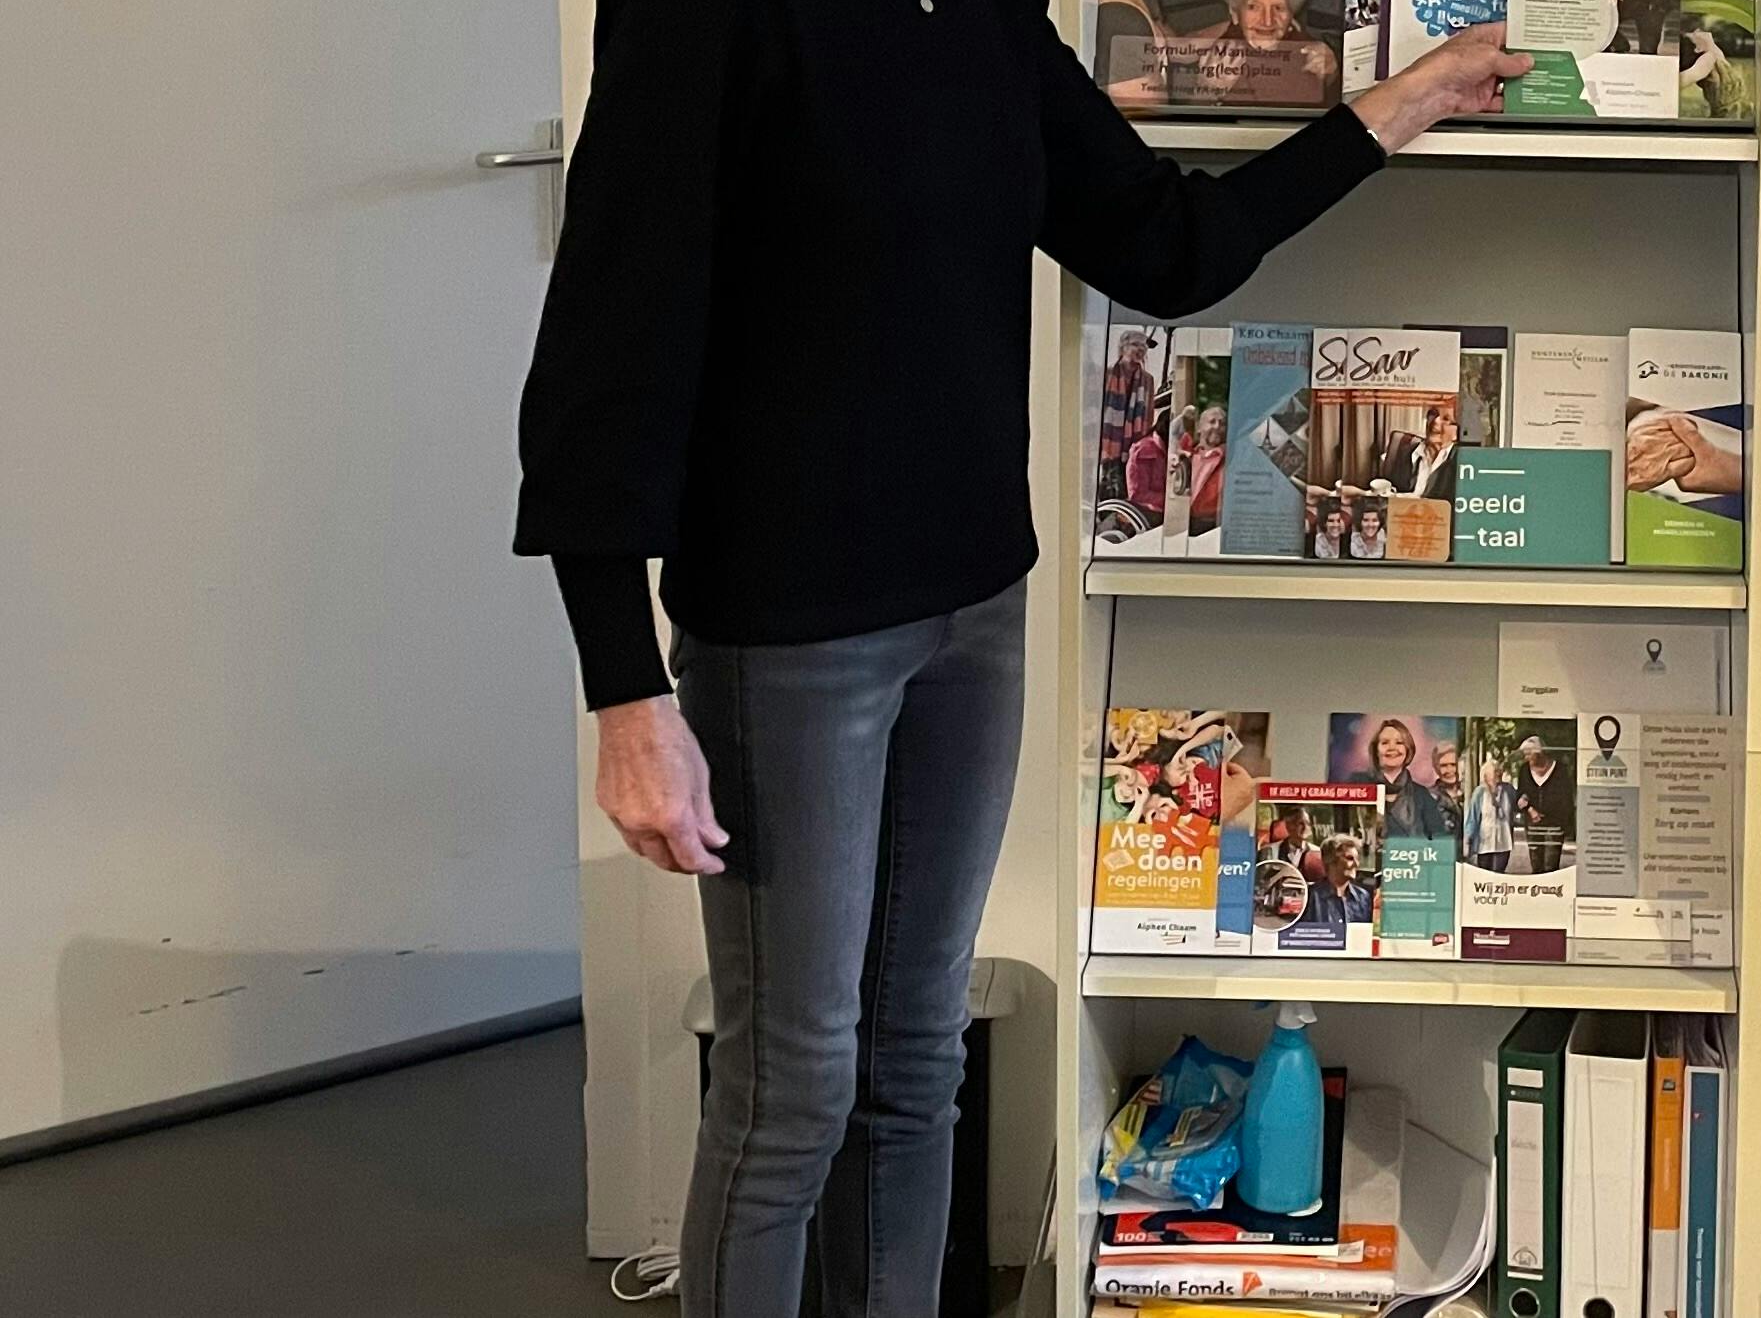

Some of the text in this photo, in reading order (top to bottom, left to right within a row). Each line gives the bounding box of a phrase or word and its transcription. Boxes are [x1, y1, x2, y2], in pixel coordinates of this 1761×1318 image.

[1142, 42, 1208, 57] Formulier
[1680, 369, 1730, 381] BARONIE
[1476, 527, 1526, 548] taal
[1520, 685, 1559, 696] Zorgplan
[1110, 825, 1168, 851] Mee
[1137, 849, 1204, 872] doen
[1390, 848, 1438, 864] zeg ik
[1106, 871, 1202, 893] regelingen
[1473, 882, 1494, 894] Wij
[1494, 882, 1517, 896] zijn
[1517, 884, 1529, 894] er
[1473, 895, 1509, 906] voor u
[1115, 1232, 1147, 1243] 100
[1104, 1278, 1236, 1297] Oranje Fonds
